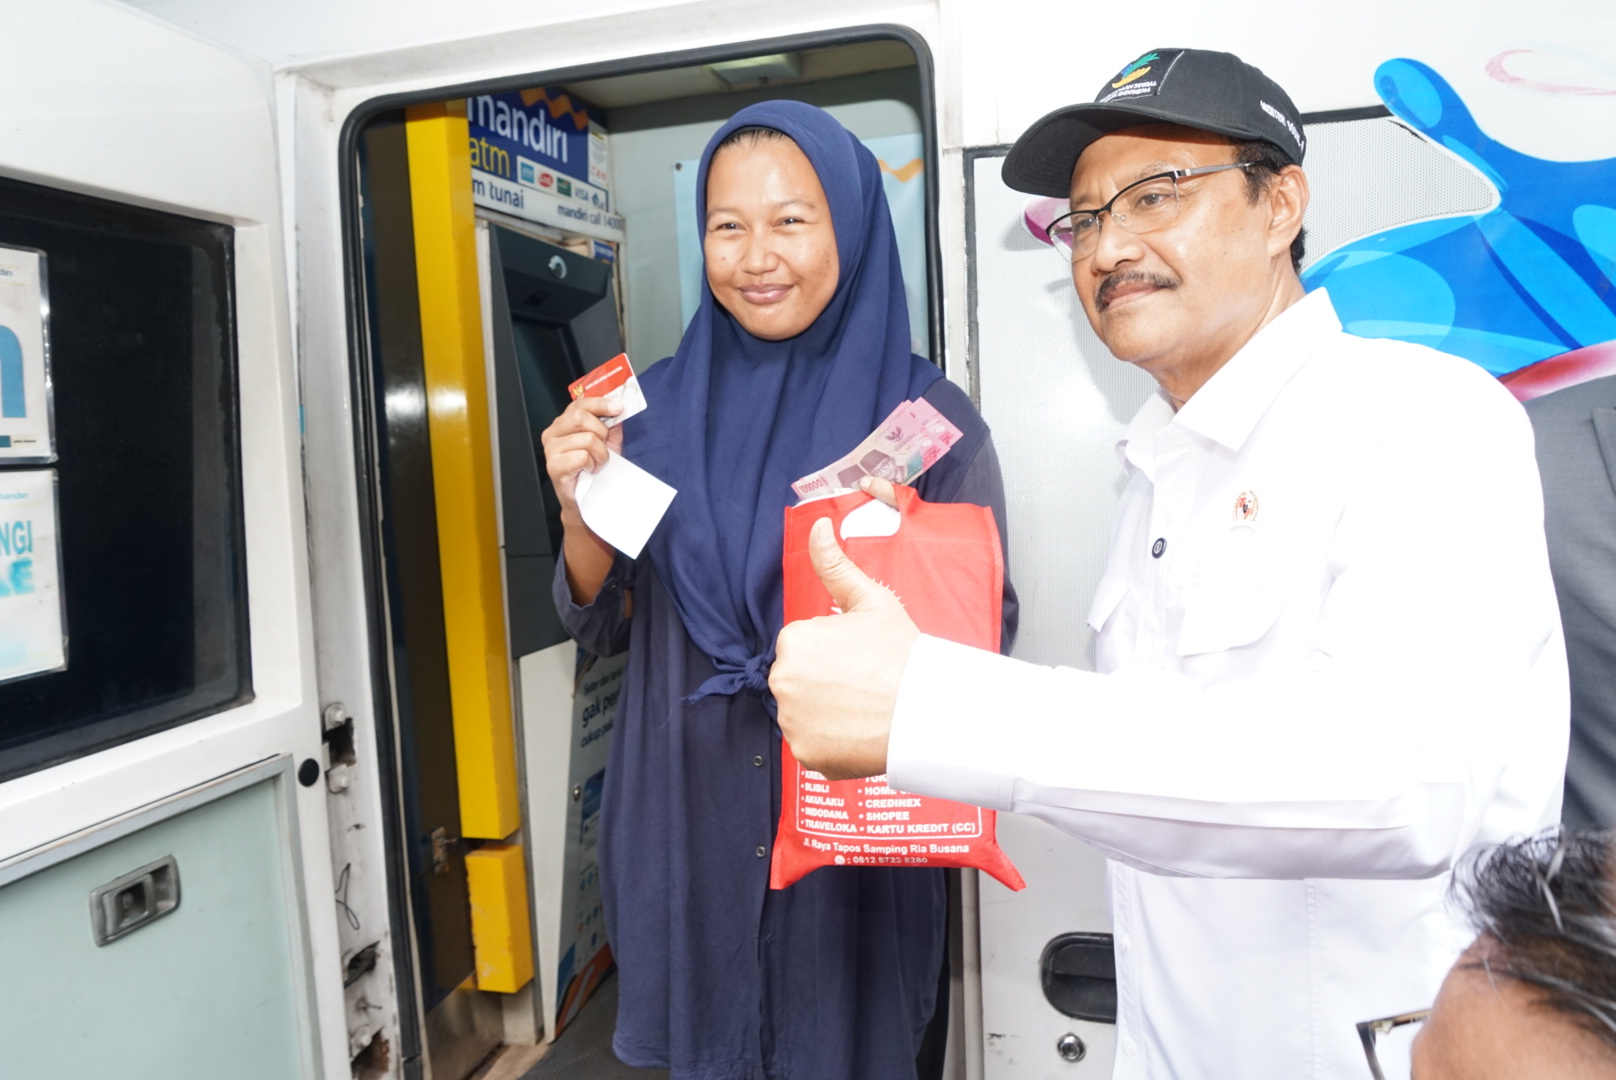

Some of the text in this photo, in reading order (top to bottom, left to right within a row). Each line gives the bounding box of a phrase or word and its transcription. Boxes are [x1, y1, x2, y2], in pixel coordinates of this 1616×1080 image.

[467, 94, 569, 164] mandiri
[470, 136, 511, 178] atm
[489, 181, 524, 208] tunai
[558, 205, 589, 222] mandiri
[582, 695, 601, 729] gak
[805, 782, 830, 793] BLIBLI
[805, 795, 845, 807] AKULAKU
[865, 798, 921, 808] CREDINEX
[805, 807, 849, 820] INDODANA
[866, 811, 910, 821] SHOPEE
[805, 819, 857, 833] TRAVELOKA
[867, 822, 976, 834] KARTU KREDIT (CC)
[811, 839, 831, 852] Raya
[832, 842, 861, 854] Tapos
[863, 844, 908, 855] Samping
[909, 844, 927, 853] Ria
[929, 844, 970, 853] Busana
[852, 856, 876, 864] 0812
